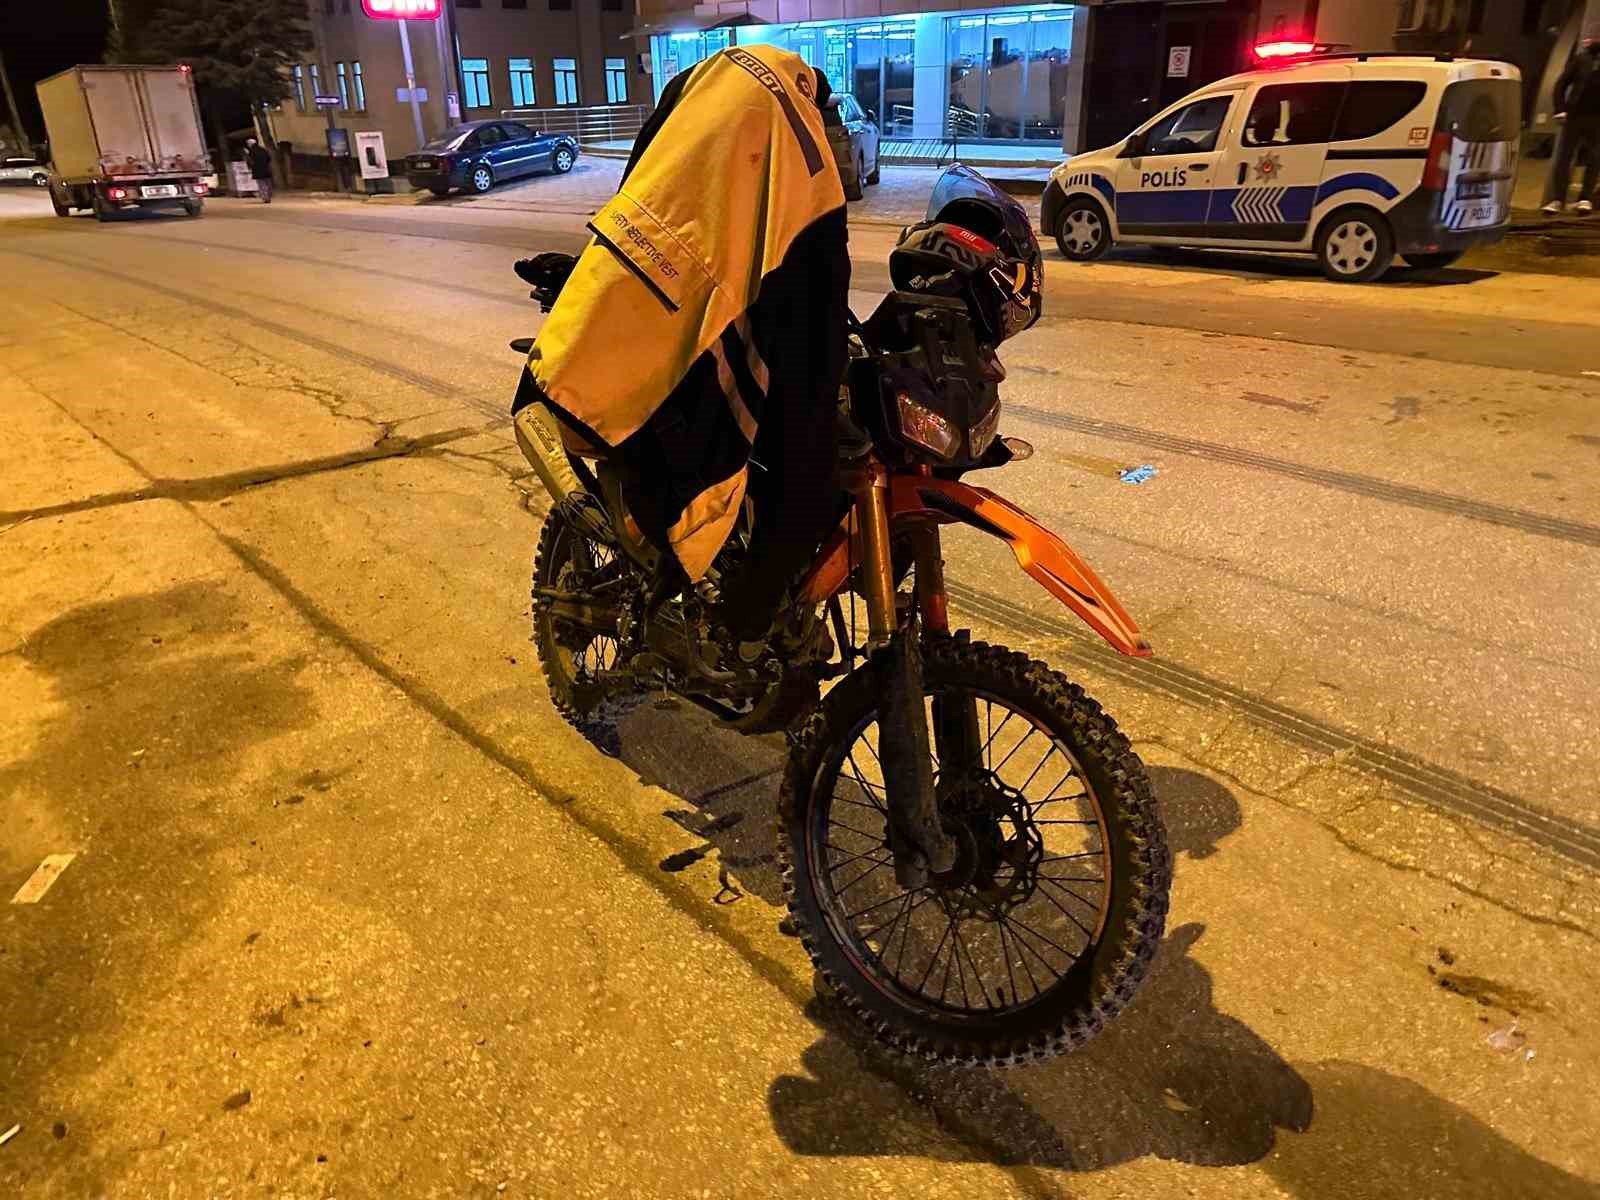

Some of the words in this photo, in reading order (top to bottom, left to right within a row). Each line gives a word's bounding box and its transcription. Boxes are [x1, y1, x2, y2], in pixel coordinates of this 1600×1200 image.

[1141, 166, 1186, 188] POLİS
[627, 225, 663, 263] REFLECTIVE
[659, 259, 679, 279] VEST
